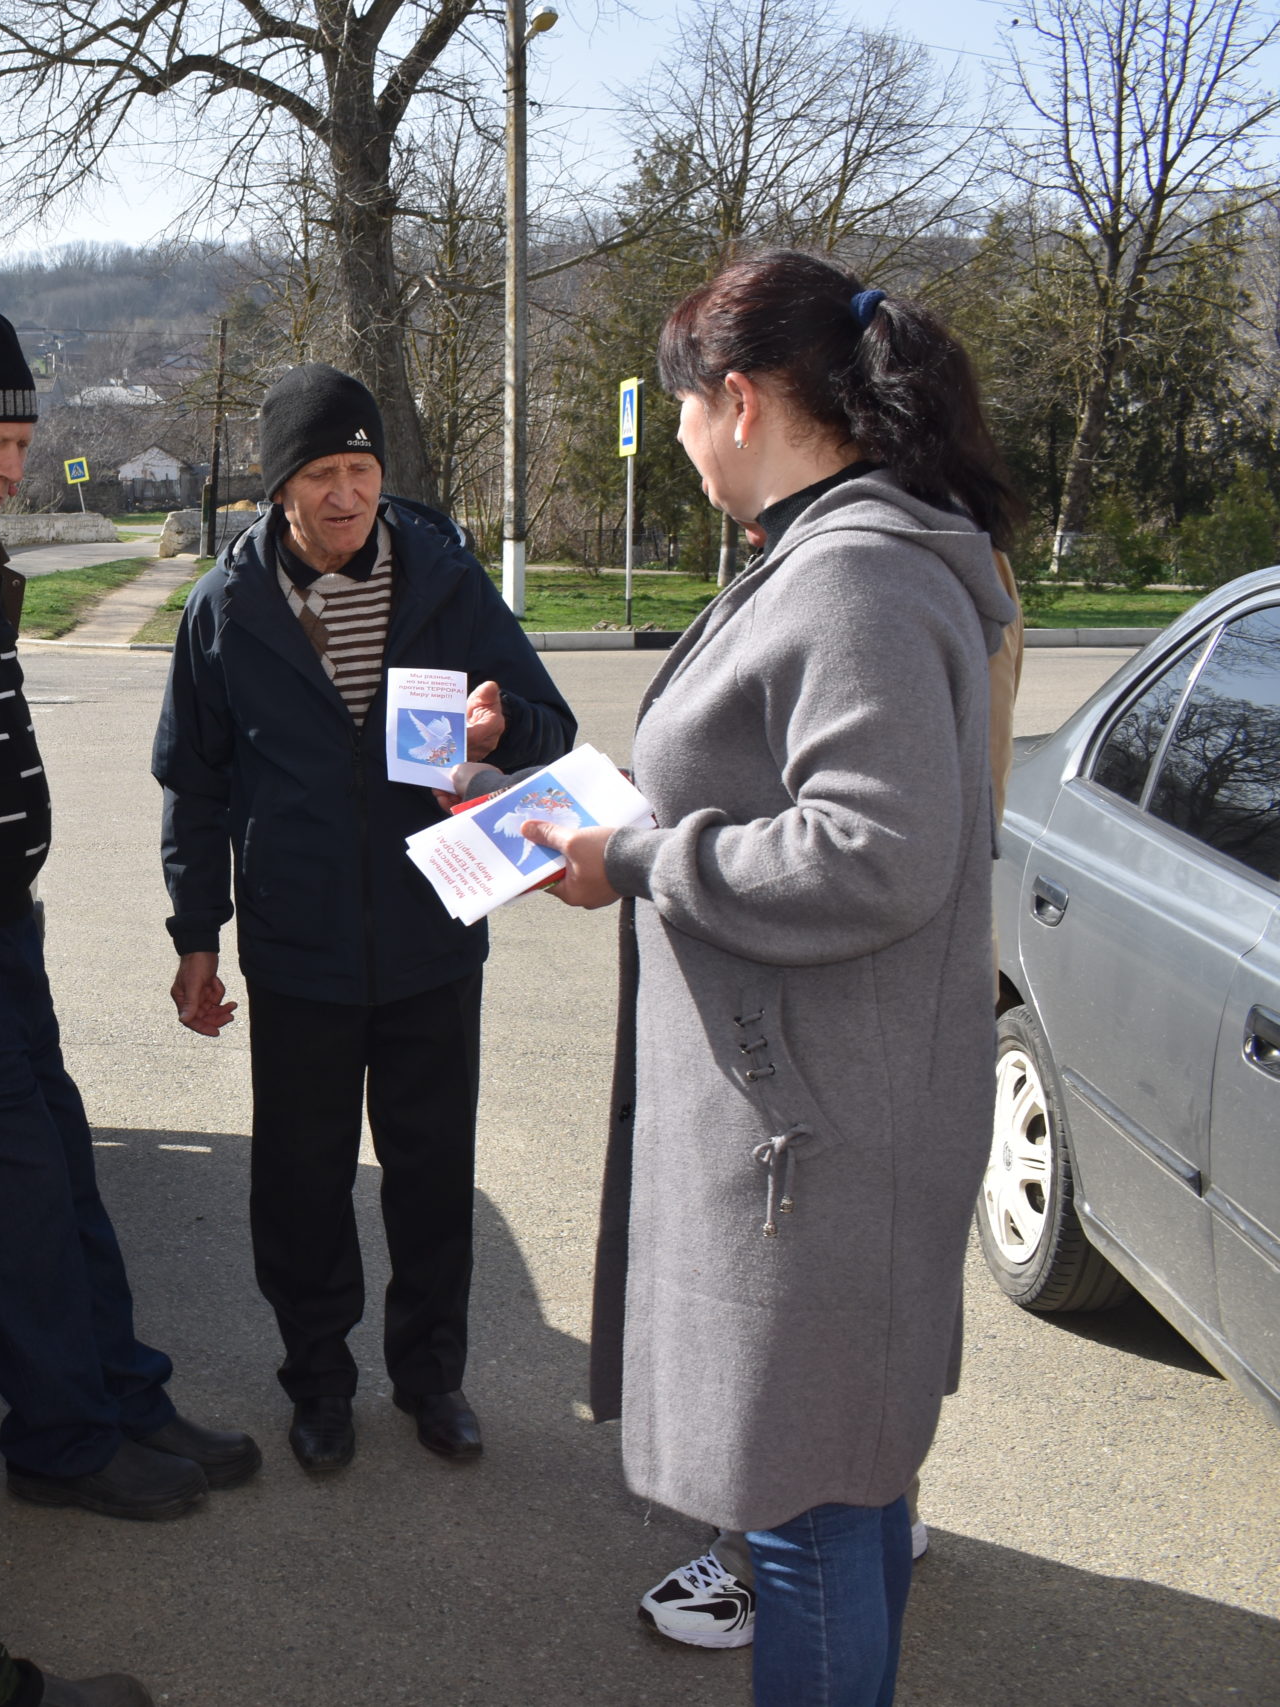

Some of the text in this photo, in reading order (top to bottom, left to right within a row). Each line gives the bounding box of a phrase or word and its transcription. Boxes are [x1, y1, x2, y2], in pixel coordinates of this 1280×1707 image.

[346, 439, 372, 447] adidas
[434, 847, 478, 895] но мы вместе
[474, 861, 495, 882] Миру
[452, 884, 466, 899] Мы
[469, 871, 494, 896] против
